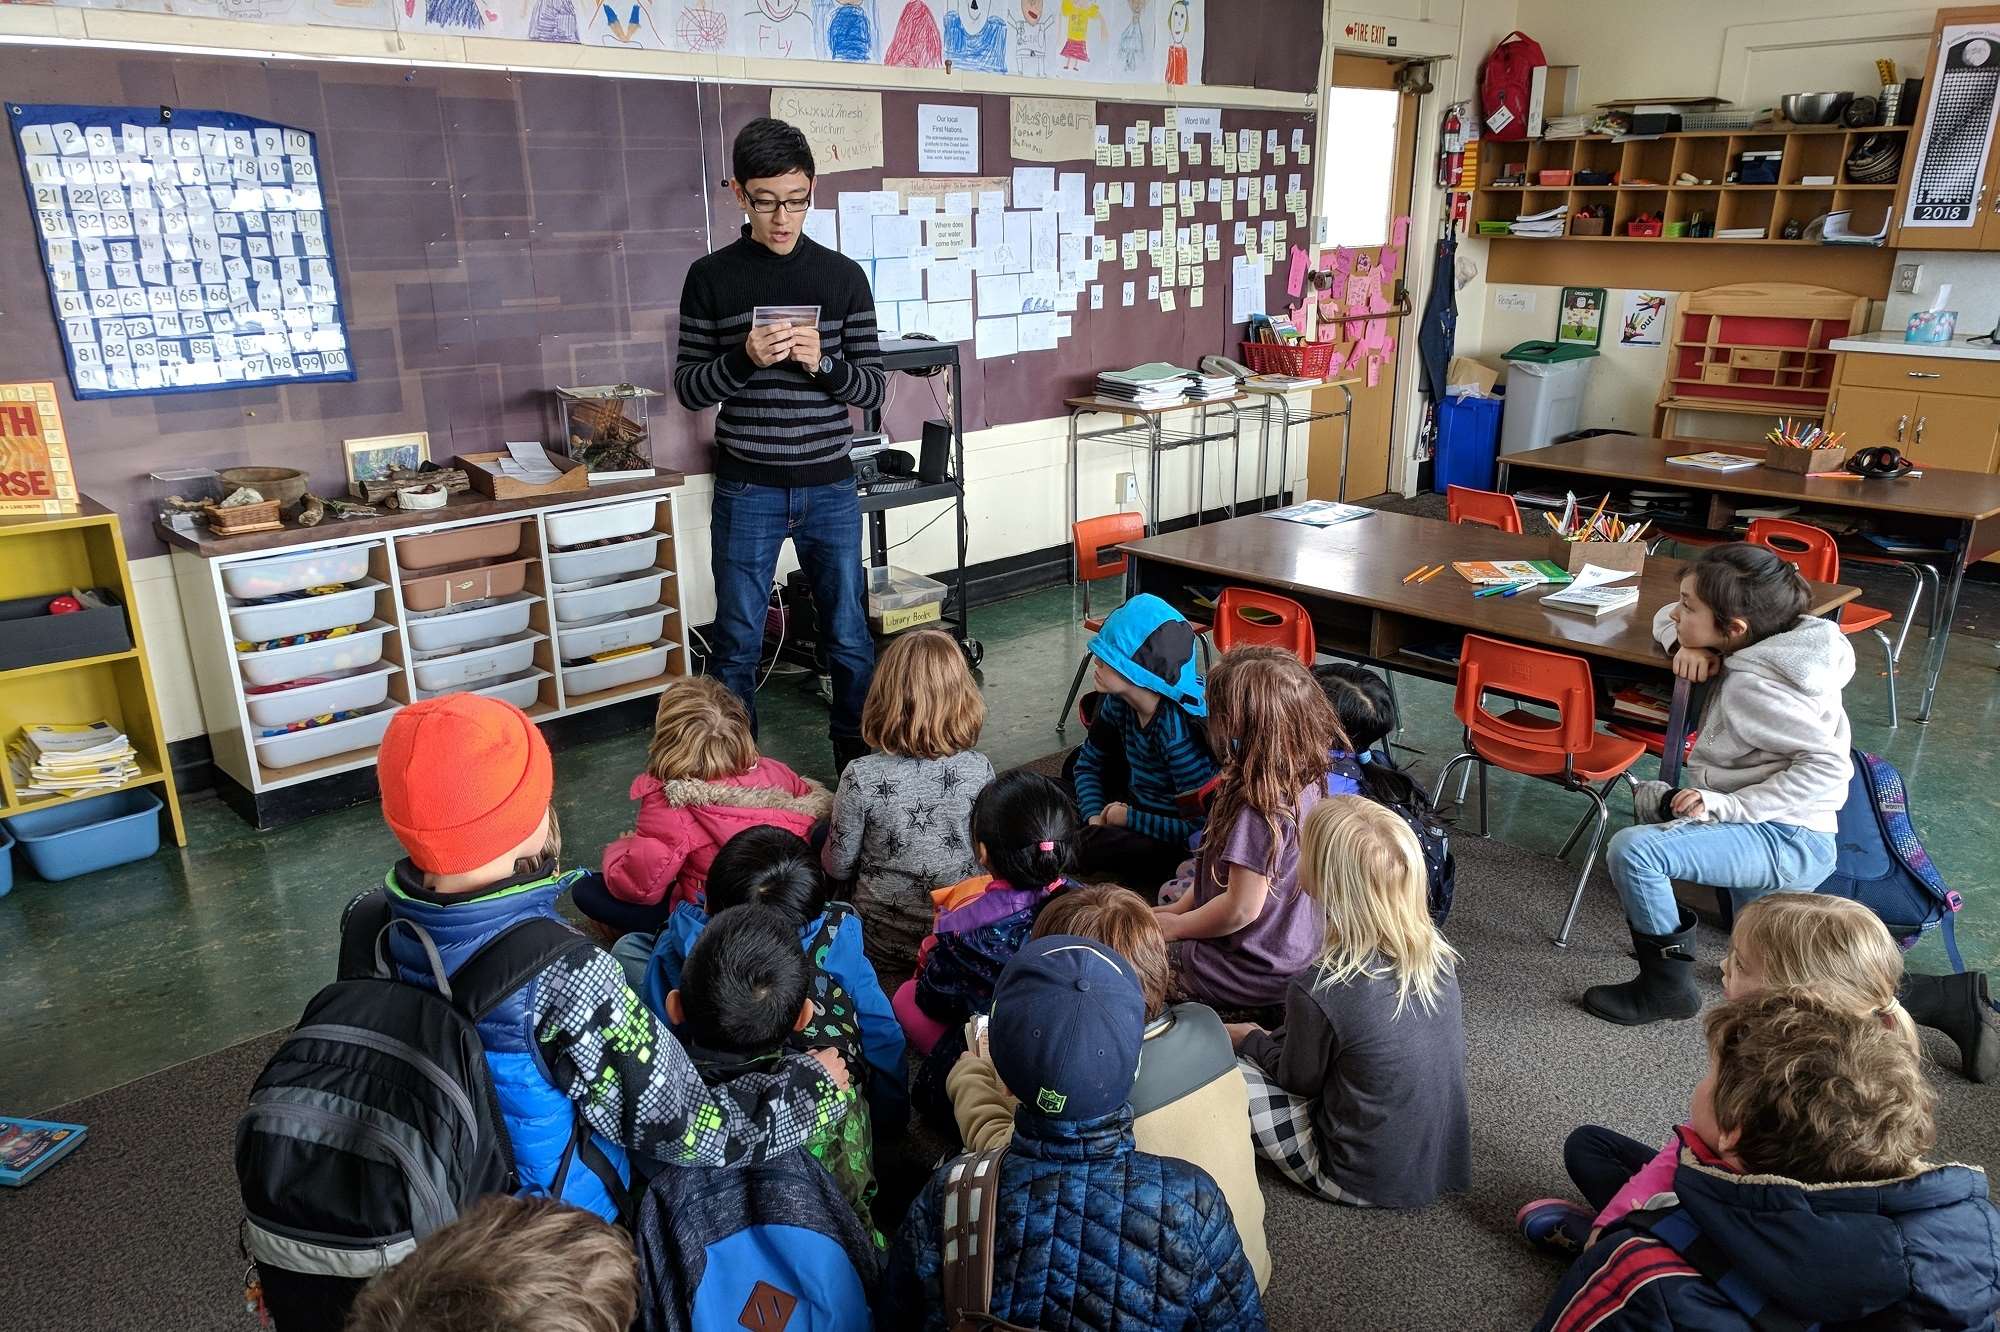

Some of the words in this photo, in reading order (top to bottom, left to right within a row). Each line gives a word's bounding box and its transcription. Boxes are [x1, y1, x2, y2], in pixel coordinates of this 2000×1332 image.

[1354, 22, 1368, 42] FIRE
[1371, 24, 1386, 44] EXIT
[1185, 116, 1198, 125] Word
[1200, 117, 1210, 125] Wall
[36, 131, 42, 146] 1
[63, 129, 74, 144] 2
[94, 133, 105, 147] 3
[153, 136, 162, 148] 5
[181, 137, 190, 151] 6
[207, 133, 217, 147] 7
[234, 136, 244, 150] 8
[265, 136, 274, 150] 9
[288, 134, 306, 148] 10
[36, 162, 52, 177] 11
[68, 163, 86, 176] 12
[95, 160, 115, 175] 13
[211, 162, 226, 176] 17
[240, 159, 256, 175] 18
[264, 162, 280, 176] 19
[294, 162, 313, 176] 20
[38, 188, 58, 203] 21
[73, 189, 95, 204] 22
[100, 190, 122, 204] 23
[44, 217, 64, 232] 31
[78, 214, 100, 229] 32
[108, 215, 128, 230] 33
[167, 212, 184, 229] 35
[219, 214, 232, 228] 37
[248, 214, 261, 229] 38
[271, 214, 286, 228] 39
[299, 212, 318, 227] 40
[1921, 206, 1961, 219] 2018
[112, 246, 129, 258] 43
[194, 237, 212, 250] 46
[224, 242, 236, 251] 47
[308, 235, 320, 248] 50
[60, 271, 71, 281] 51
[90, 267, 101, 278] 52
[205, 263, 219, 276] 56
[284, 264, 296, 276] 59
[64, 297, 82, 310] 61
[96, 294, 117, 308] 62
[124, 293, 142, 307] 63
[180, 290, 198, 303] 65
[210, 288, 228, 302] 66
[69, 323, 88, 336] 71
[103, 324, 124, 336] 72
[126, 322, 148, 336] 73
[156, 317, 176, 330] 74
[184, 316, 204, 329] 75
[212, 313, 228, 326] 76
[233, 301, 250, 318] 77
[79, 348, 97, 361] 81
[105, 344, 126, 358] 82
[134, 343, 155, 356] 83
[160, 344, 179, 357] 84
[192, 342, 211, 354] 85
[248, 360, 264, 372] 97
[273, 357, 292, 370] 98
[302, 357, 320, 370] 99
[324, 352, 345, 365] 100
[886, 614, 911, 626] Library
[913, 612, 931, 622] Books
